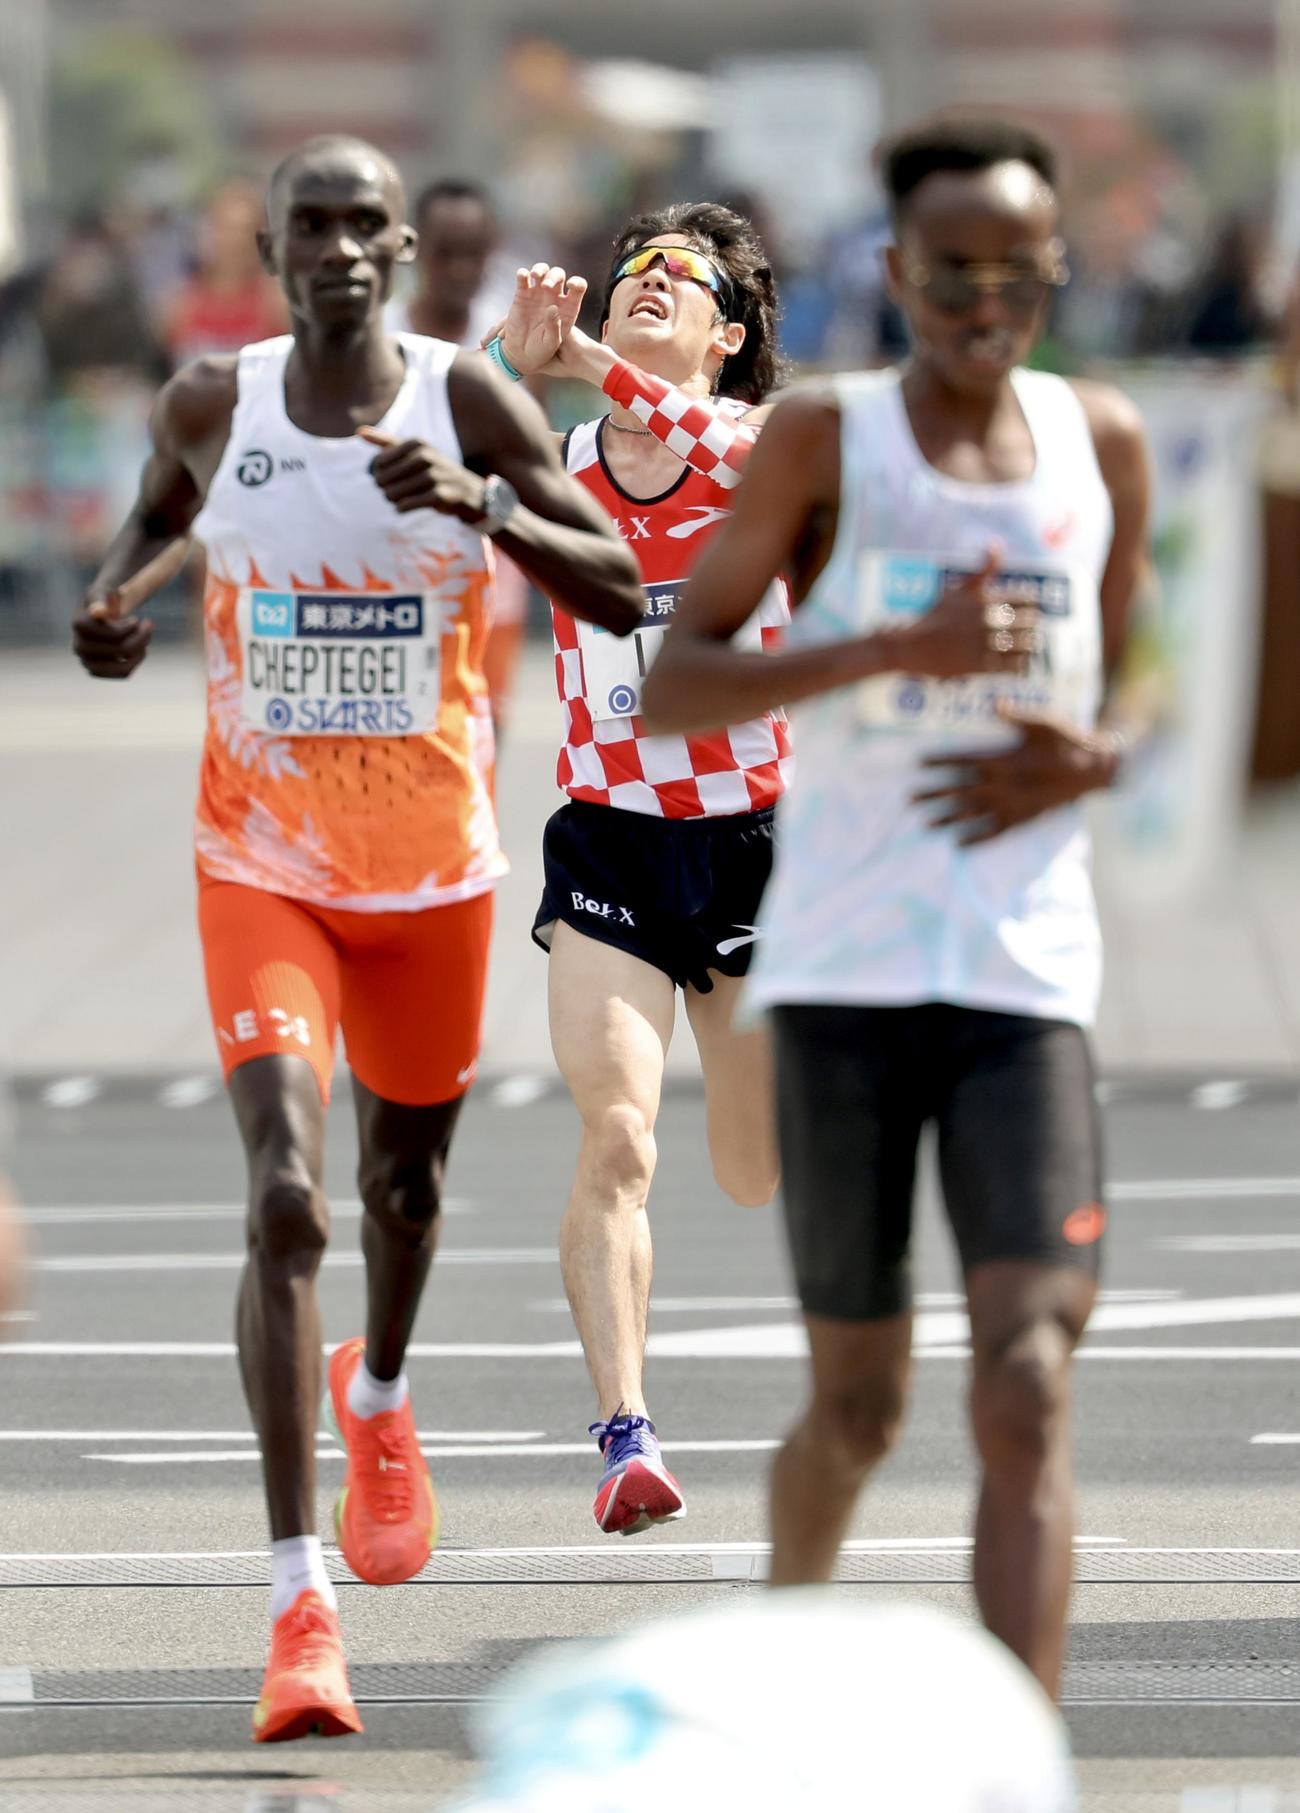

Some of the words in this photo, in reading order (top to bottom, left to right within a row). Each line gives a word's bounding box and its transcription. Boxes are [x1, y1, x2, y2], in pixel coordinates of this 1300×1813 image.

[301, 602, 419, 631] 東京メトロ
[249, 642, 406, 694] CHEPTEGEI
